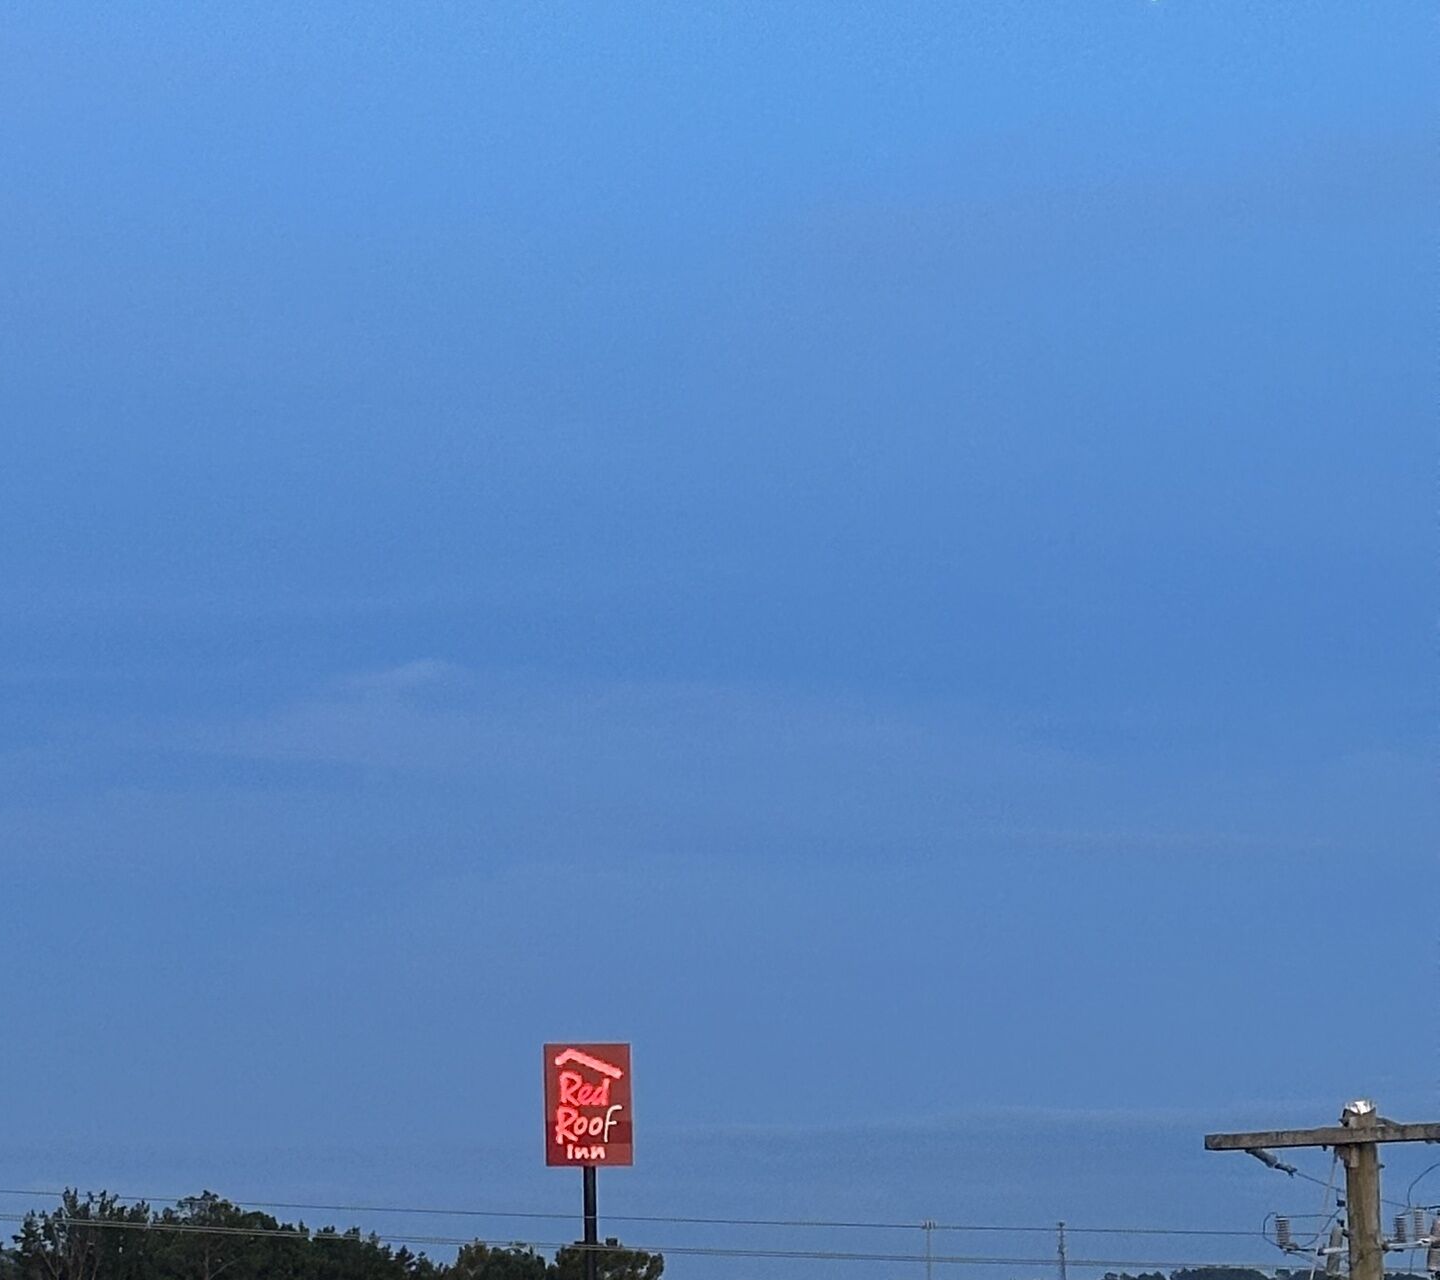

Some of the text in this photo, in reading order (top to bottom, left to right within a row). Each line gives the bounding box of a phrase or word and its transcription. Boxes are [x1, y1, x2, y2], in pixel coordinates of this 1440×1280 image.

[559, 1071, 610, 1106] Red
[556, 1105, 623, 1144] Roof
[567, 1144, 606, 1160] Inn
